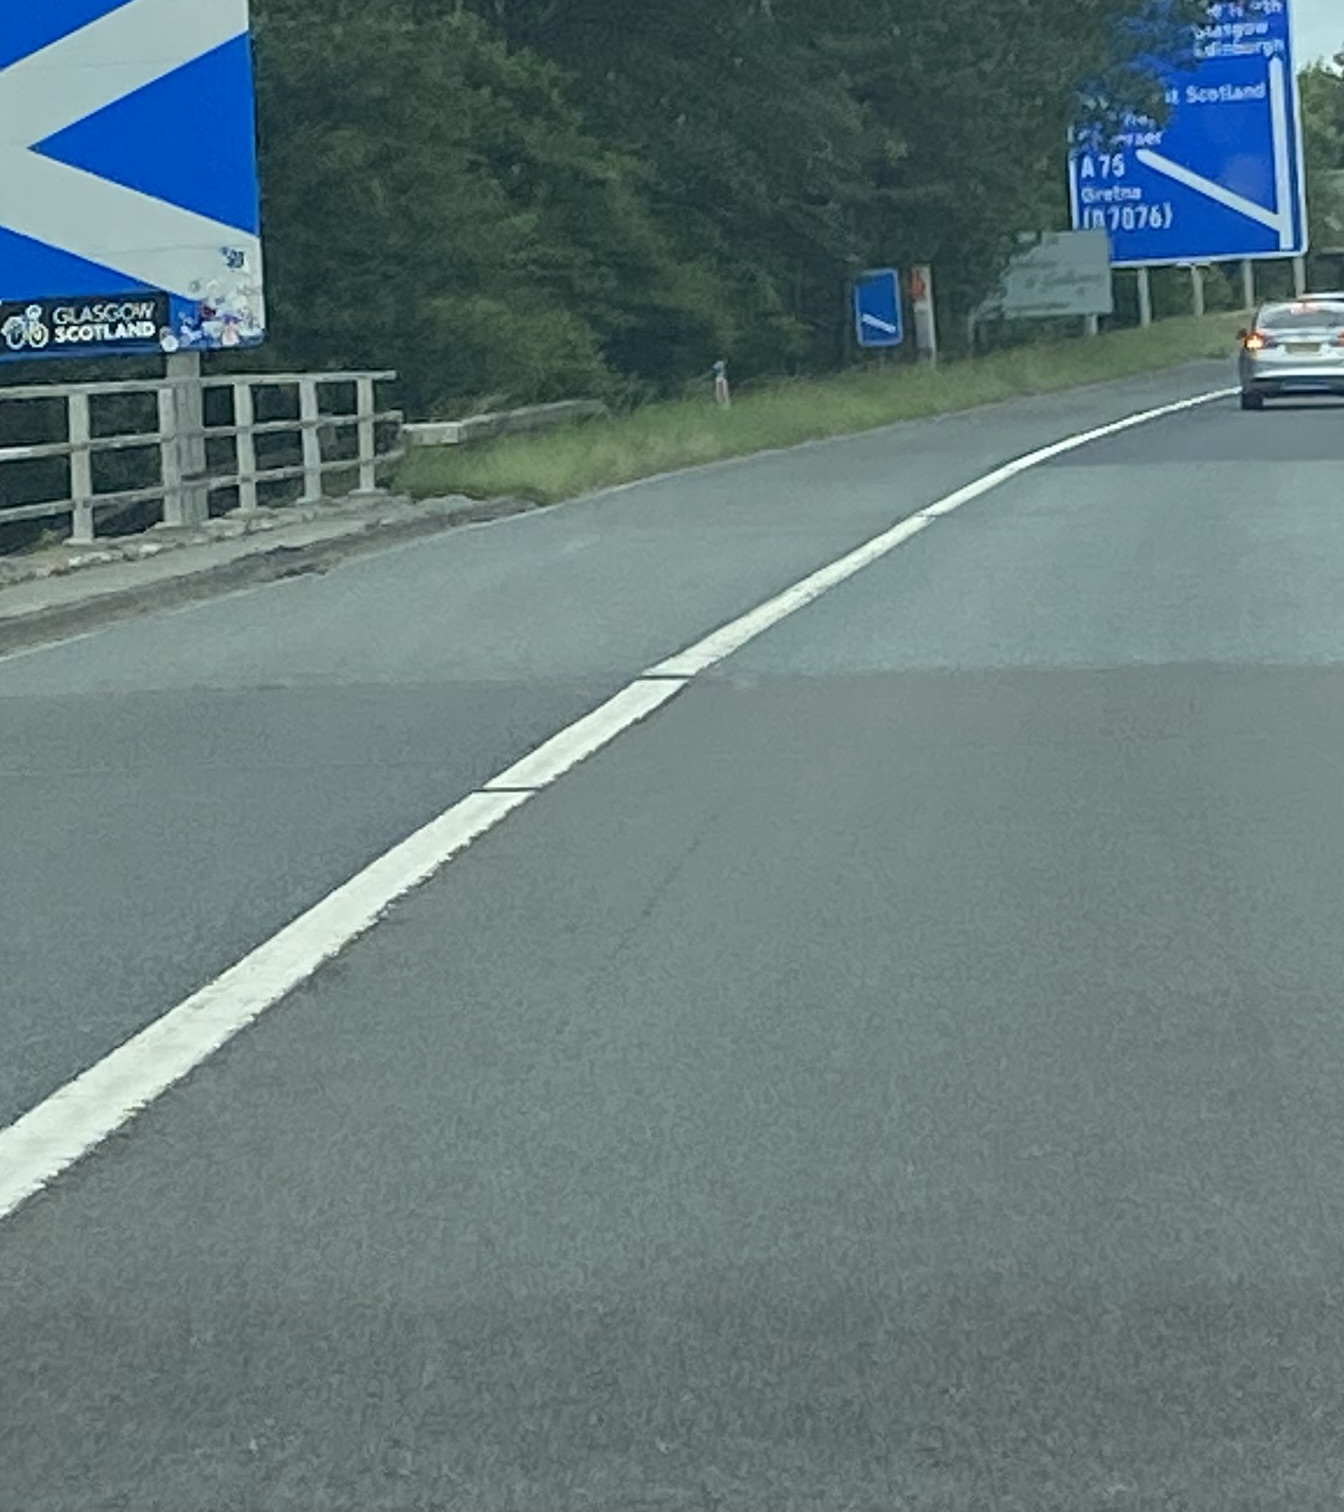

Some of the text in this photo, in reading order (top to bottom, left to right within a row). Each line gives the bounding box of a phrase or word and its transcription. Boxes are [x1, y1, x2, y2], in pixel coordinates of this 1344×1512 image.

[1186, 82, 1267, 104] Scotland
[53, 302, 155, 325] GLASGOW
[54, 321, 156, 343] SCOTLAND
